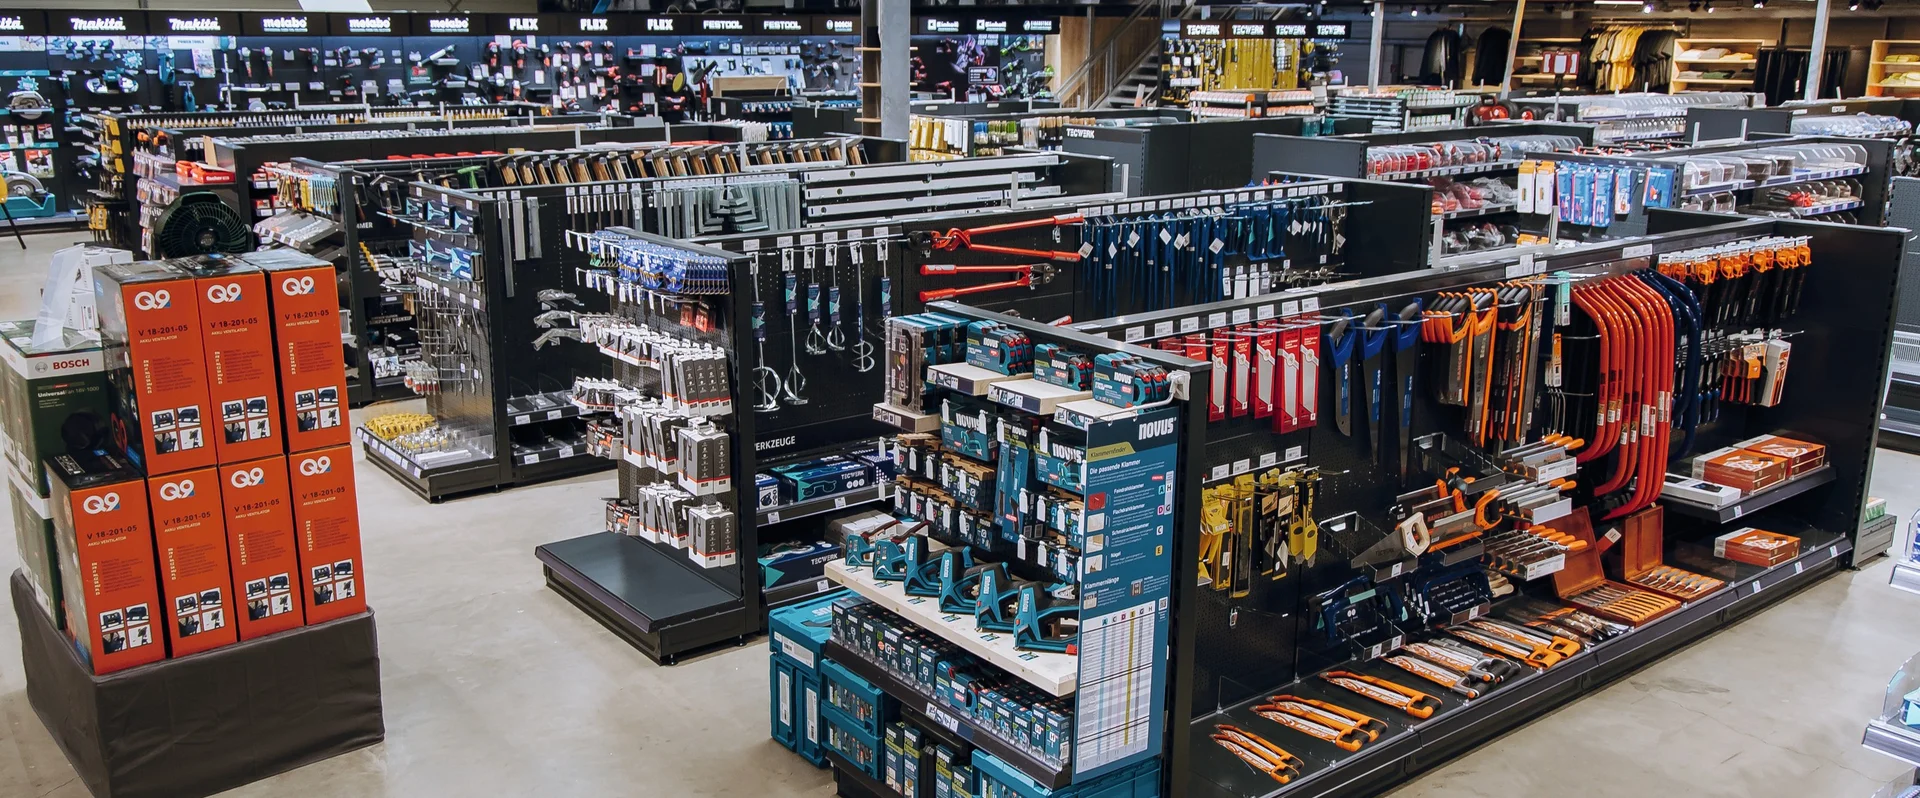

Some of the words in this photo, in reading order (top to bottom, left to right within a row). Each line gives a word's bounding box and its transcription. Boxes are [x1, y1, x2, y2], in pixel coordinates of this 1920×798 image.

[263, 17, 306, 28] metabo
[349, 17, 390, 28] metabo
[430, 18, 469, 28] metabo
[509, 18, 538, 30] FLEX
[580, 19, 608, 30] FLEX
[647, 19, 673, 30] FLEX
[1186, 24, 1220, 35] TECWERK
[1232, 25, 1264, 35] TECWERK
[1276, 25, 1306, 35] TECWERK
[1317, 25, 1345, 35] TECWERK
[1066, 128, 1094, 139] TECWERK
[282, 276, 314, 296] Q9
[208, 283, 241, 303] Q9
[135, 290, 170, 310] Q9
[293, 310, 329, 319] 18-201-05
[219, 317, 258, 327] 18-201-05
[148, 325, 188, 335] 18-201-05
[983, 338, 999, 348] novus
[53, 359, 89, 370] BOSCH
[1051, 360, 1067, 370] novus
[1114, 372, 1132, 384] novus
[1012, 426, 1027, 437] novus
[1138, 418, 1174, 440] novus
[754, 436, 796, 451] ERKZEUGE
[1052, 443, 1082, 463] novus
[1091, 446, 1126, 457] Klammernfinder
[300, 456, 331, 476] Q9
[1099, 463, 1120, 474] passende
[1121, 460, 1141, 468] Klammer
[231, 467, 264, 488] Q9
[841, 470, 864, 480] TECWERK
[160, 479, 195, 501] Q9
[310, 486, 345, 498] 18-201-05
[83, 492, 120, 514] Q9
[243, 499, 280, 511] 18-201-05
[172, 511, 211, 524] 18-201-05
[96, 525, 138, 538] 18-201-05
[811, 553, 837, 566] TECWERK
[885, 630, 898, 642] novus
[951, 680, 966, 694] novus
